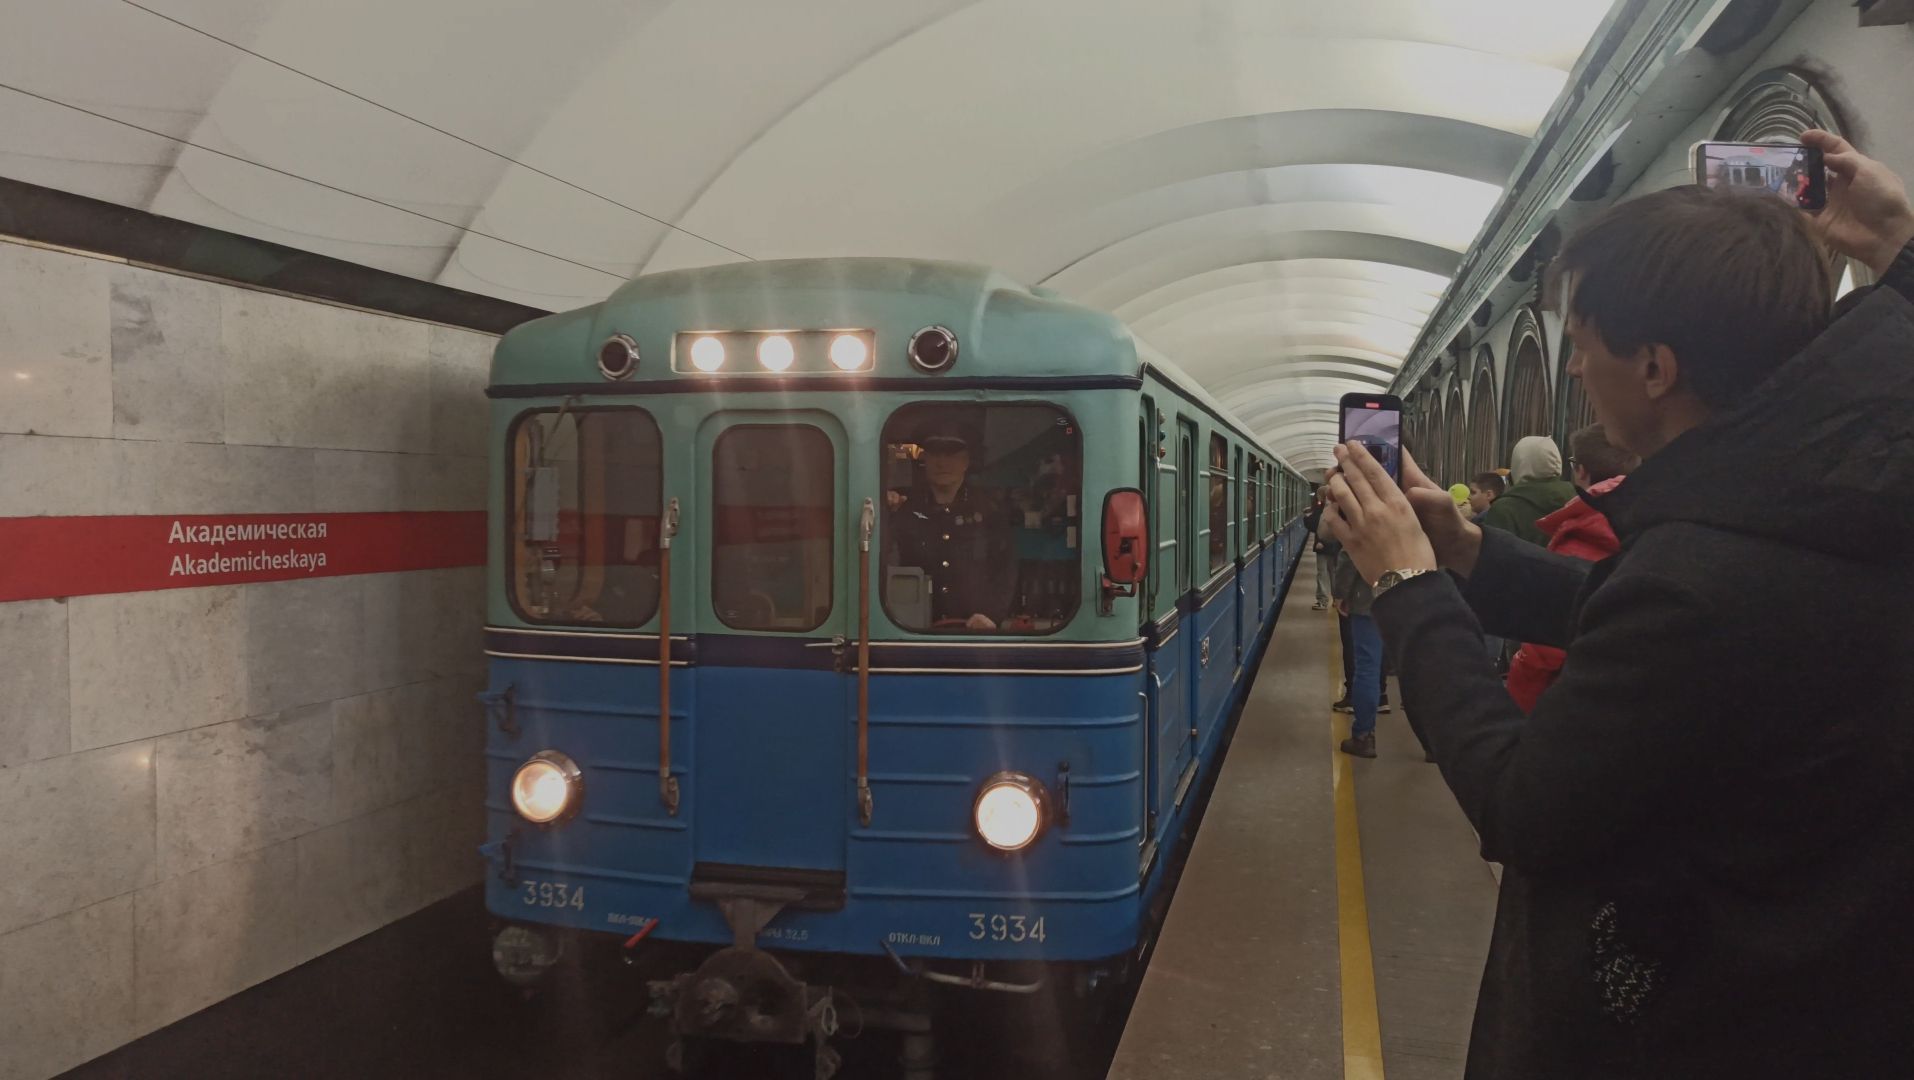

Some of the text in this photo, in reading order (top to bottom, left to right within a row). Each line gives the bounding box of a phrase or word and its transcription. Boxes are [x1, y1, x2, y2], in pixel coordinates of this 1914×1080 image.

[168, 520, 328, 546] Академическая
[169, 548, 328, 577] Akademicheskaya
[522, 880, 585, 911] 3934
[968, 913, 1047, 943] 3934
